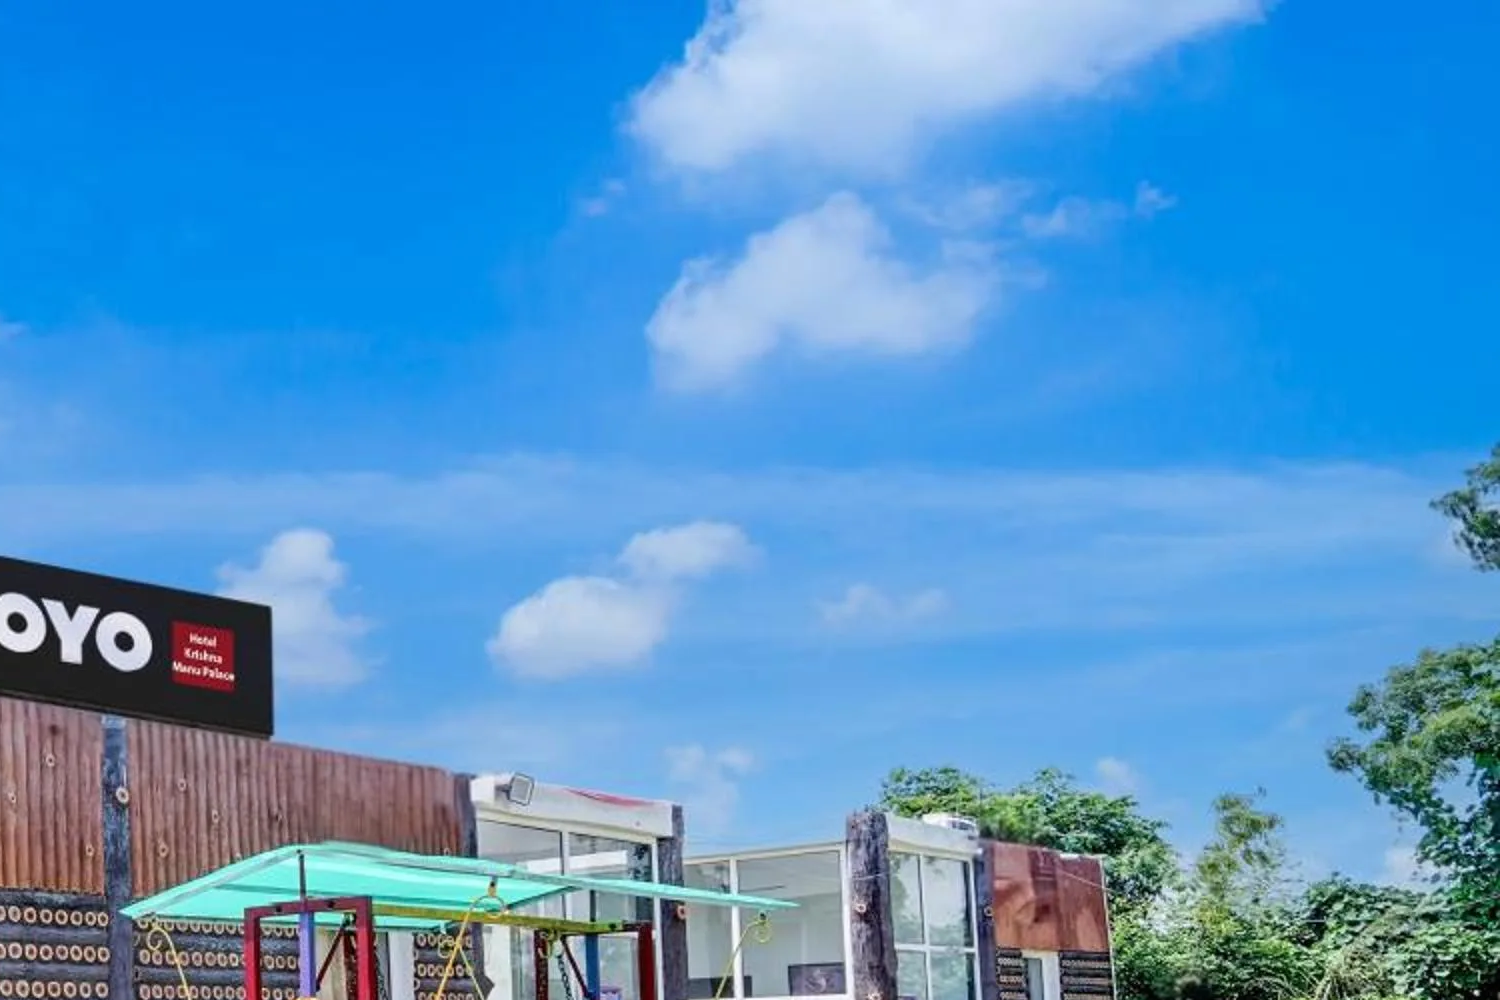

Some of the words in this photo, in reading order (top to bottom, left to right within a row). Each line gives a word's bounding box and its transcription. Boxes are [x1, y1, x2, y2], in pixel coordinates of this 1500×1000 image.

[190, 632, 217, 648] Hotel
[184, 647, 222, 664] Krishna
[203, 666, 235, 681] Palace
